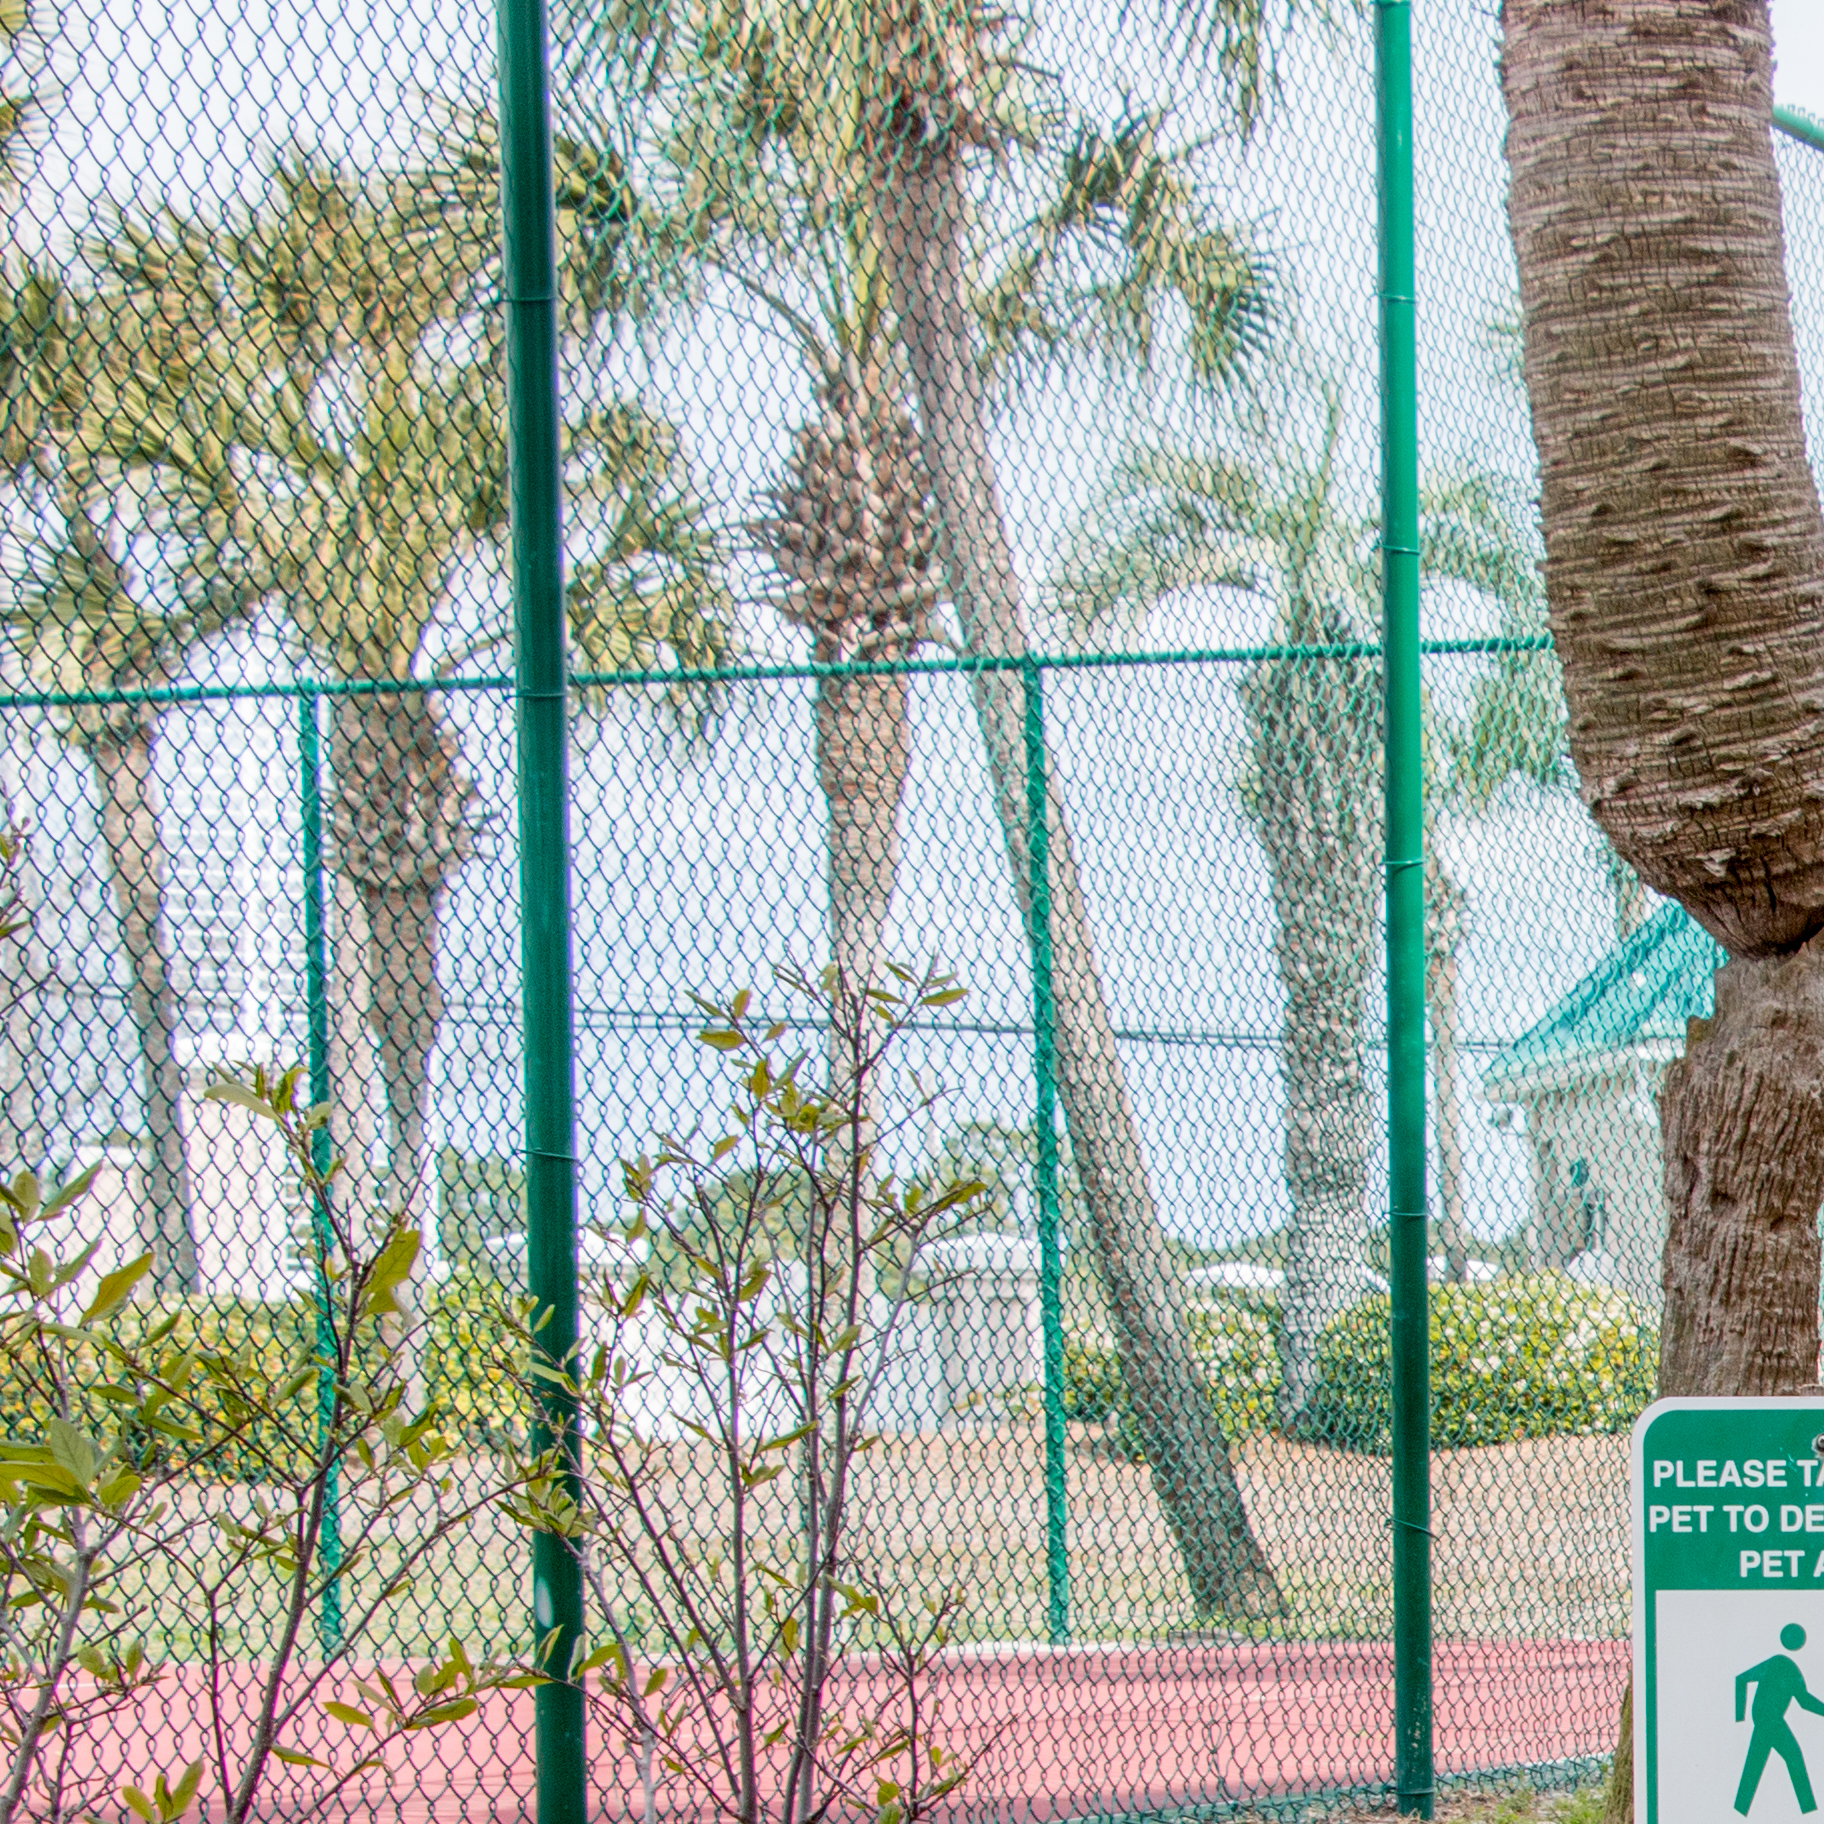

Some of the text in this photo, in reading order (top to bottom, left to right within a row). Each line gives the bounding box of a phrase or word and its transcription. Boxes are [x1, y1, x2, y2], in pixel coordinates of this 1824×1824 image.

[1653, 1460, 1788, 1488] PLEASE
[1649, 1505, 1715, 1534] PET
[1723, 1505, 1770, 1534] TO
[1739, 1550, 1806, 1579] PET
